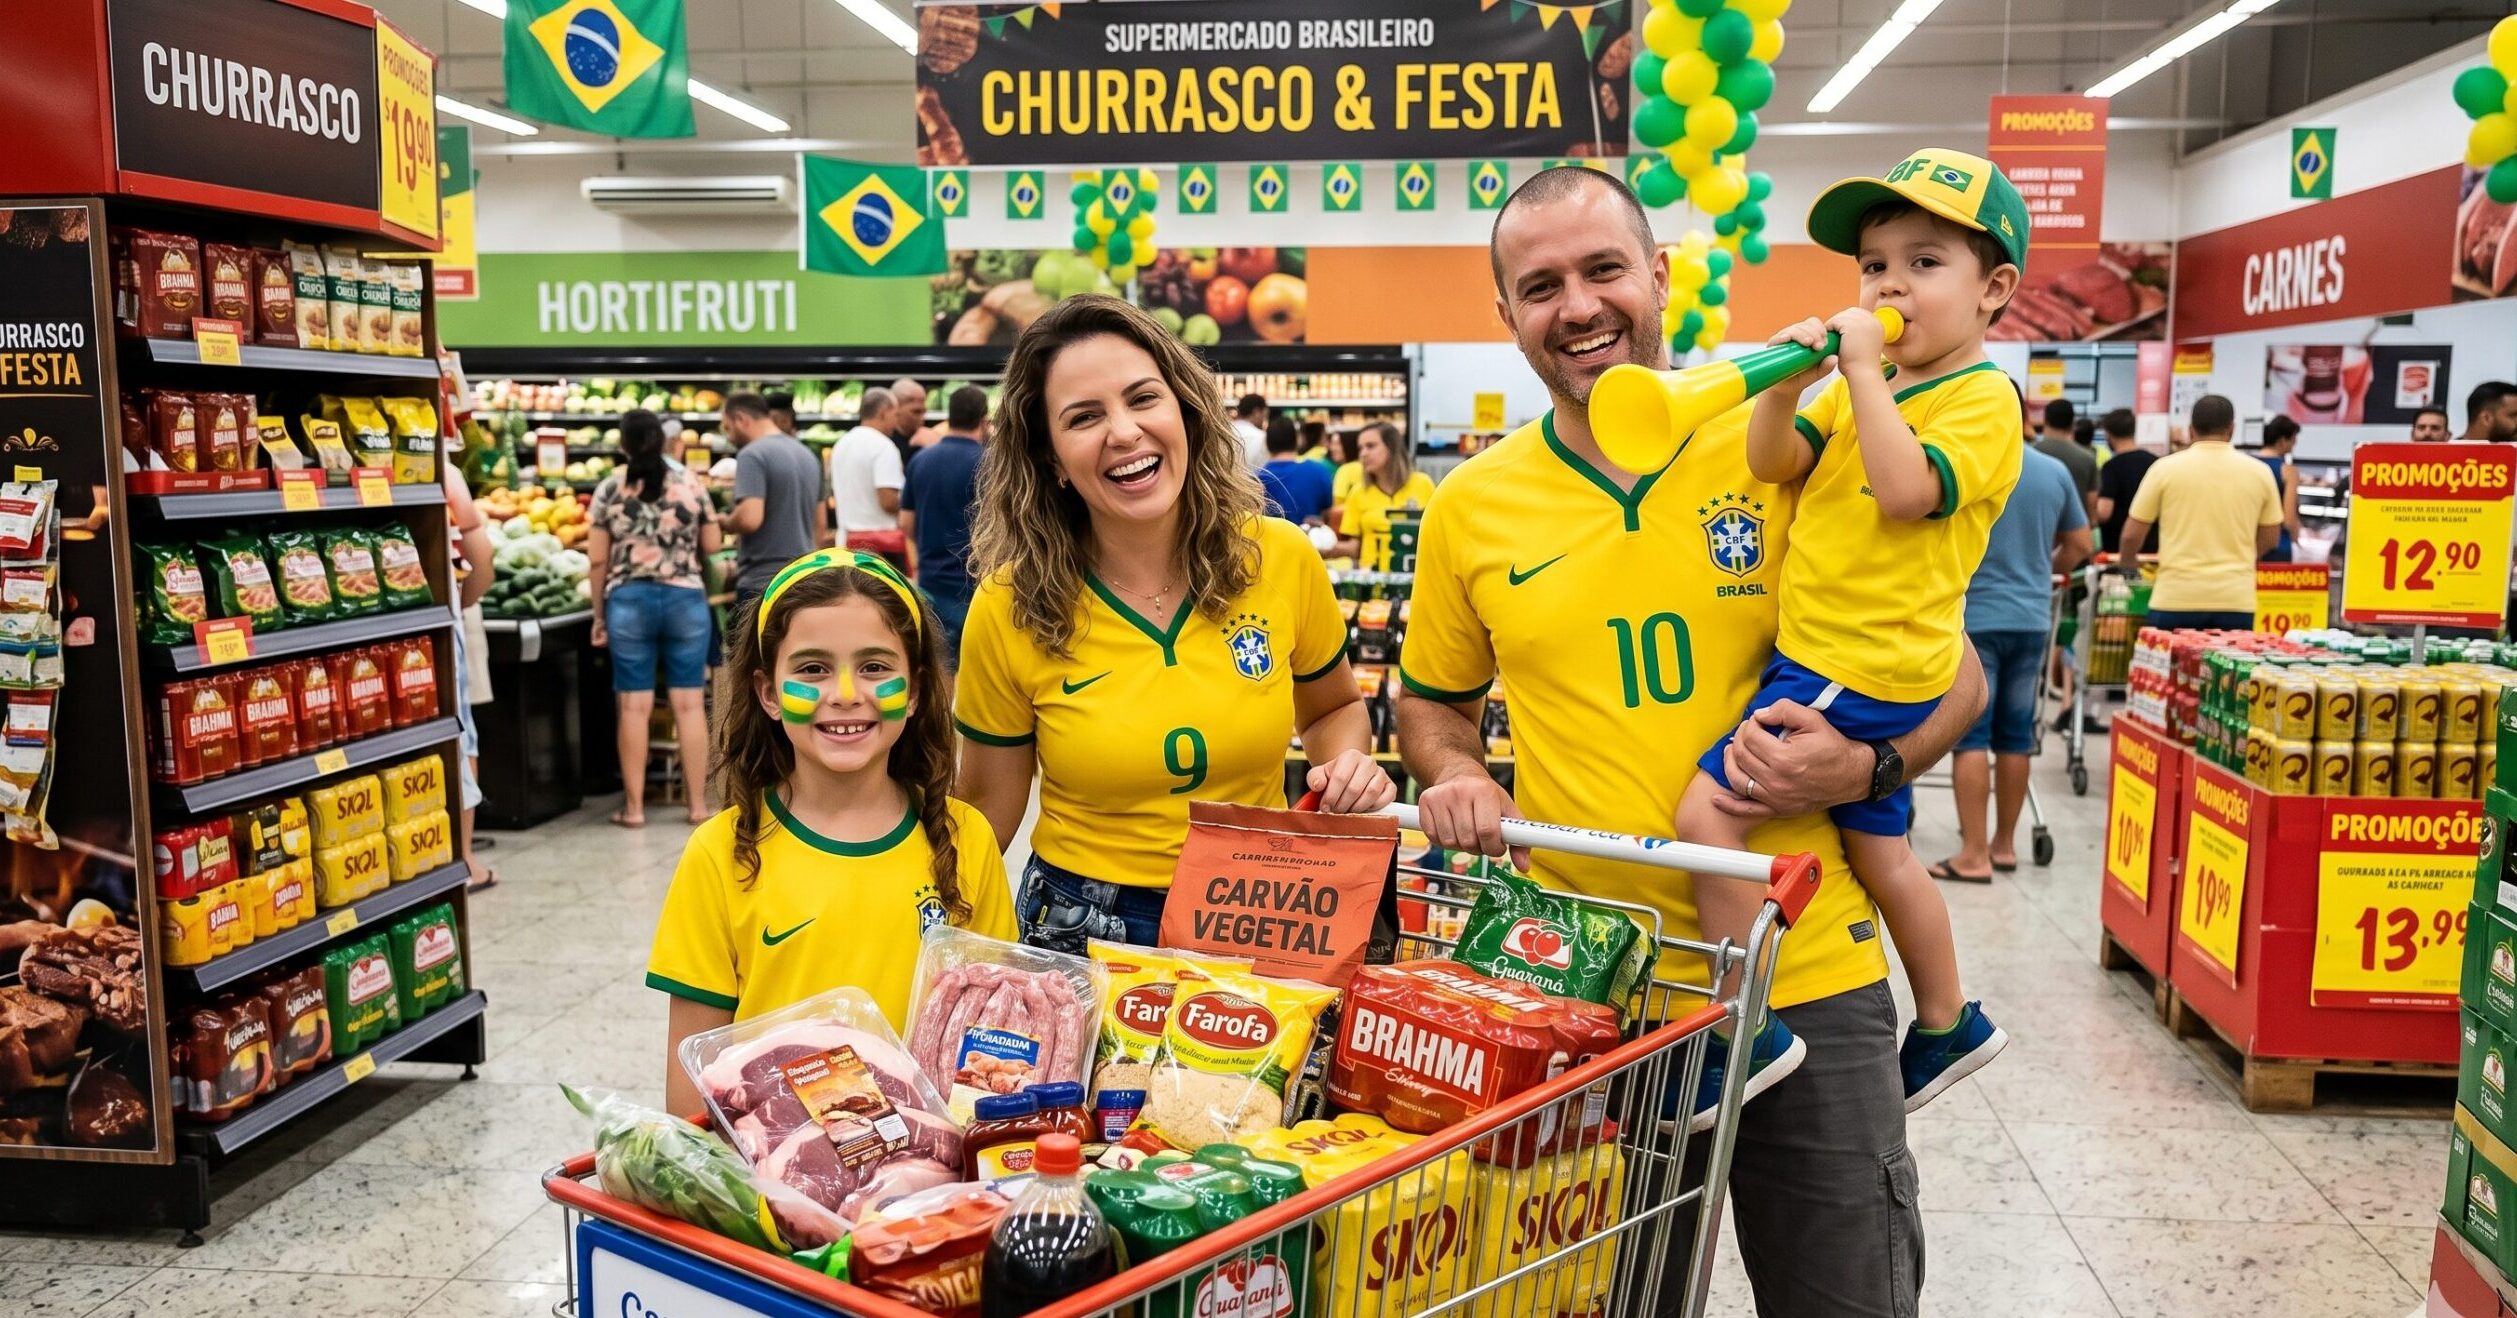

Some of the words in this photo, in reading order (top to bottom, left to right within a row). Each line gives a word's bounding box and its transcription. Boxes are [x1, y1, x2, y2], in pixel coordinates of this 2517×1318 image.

[1105, 20, 1291, 53] SUPERMERCADO
[1299, 18, 1434, 49] BRASILEIRO
[142, 41, 360, 144] CHURRASCO
[981, 64, 1309, 136] CHURRASCO
[1333, 65, 1375, 131] &
[1395, 61, 1563, 130] FESTA
[1884, 159, 1931, 183] BF
[2243, 235, 2346, 316] CARNES
[538, 280, 797, 333] HORTIFRUTI
[1, 353, 82, 385] FESTA
[2361, 459, 2508, 492] PROMOÇÕES
[1725, 535, 1745, 545] CBF
[1716, 584, 1767, 597] BRASIL
[1606, 612, 1694, 709] 10
[189, 710, 233, 737] BRAHMA
[247, 698, 288, 722] BRAHMA
[1164, 727, 1208, 794] 9
[402, 767, 437, 798] SKOL
[2194, 776, 2248, 826] PROMOÇÕES
[337, 791, 374, 820] SKOL
[411, 824, 444, 854] SKOL
[2331, 810, 2483, 850] PROMOÇÕE
[344, 847, 380, 880] SKOL
[1205, 878, 1339, 918] CARVÃO
[1194, 910, 1335, 956] VEGETAL
[1492, 956, 1565, 993] Guaraná
[1185, 1002, 1268, 1043] Farofa
[1351, 1008, 1485, 1096] BRAHMA
[1286, 1127, 1386, 1156] SKOL
[1511, 1177, 1612, 1254] SKOL
